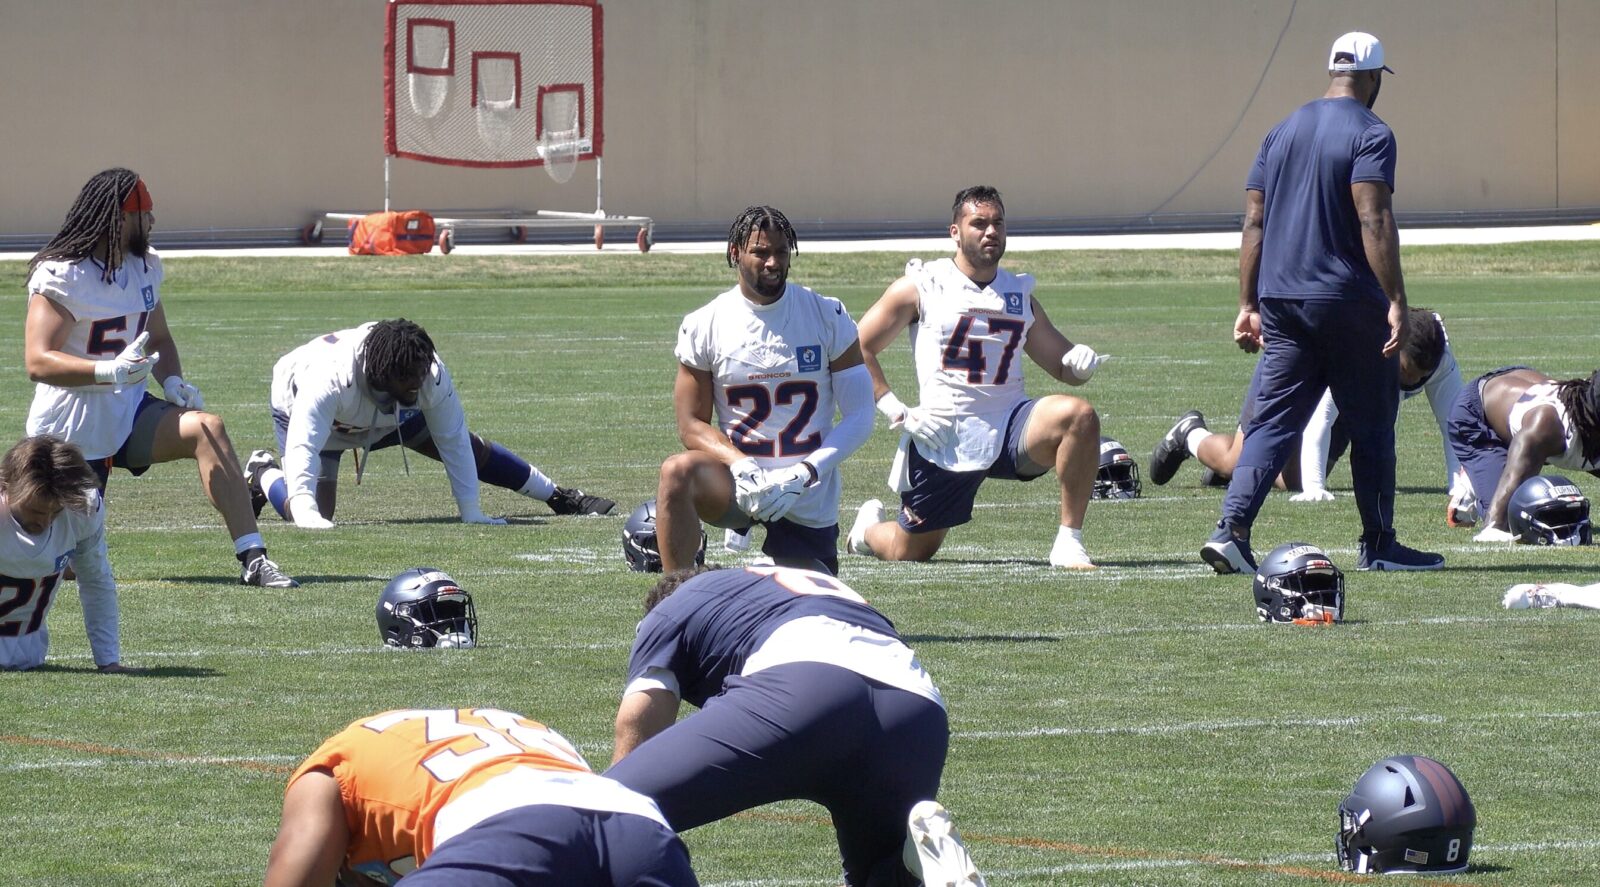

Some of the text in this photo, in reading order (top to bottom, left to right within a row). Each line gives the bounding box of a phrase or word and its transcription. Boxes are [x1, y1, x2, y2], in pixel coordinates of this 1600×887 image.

[748, 371, 792, 381] BRONCOS
[942, 315, 1025, 385] 47
[725, 381, 822, 458] 22
[0, 573, 60, 636] 21
[1446, 838, 1461, 862] 8
